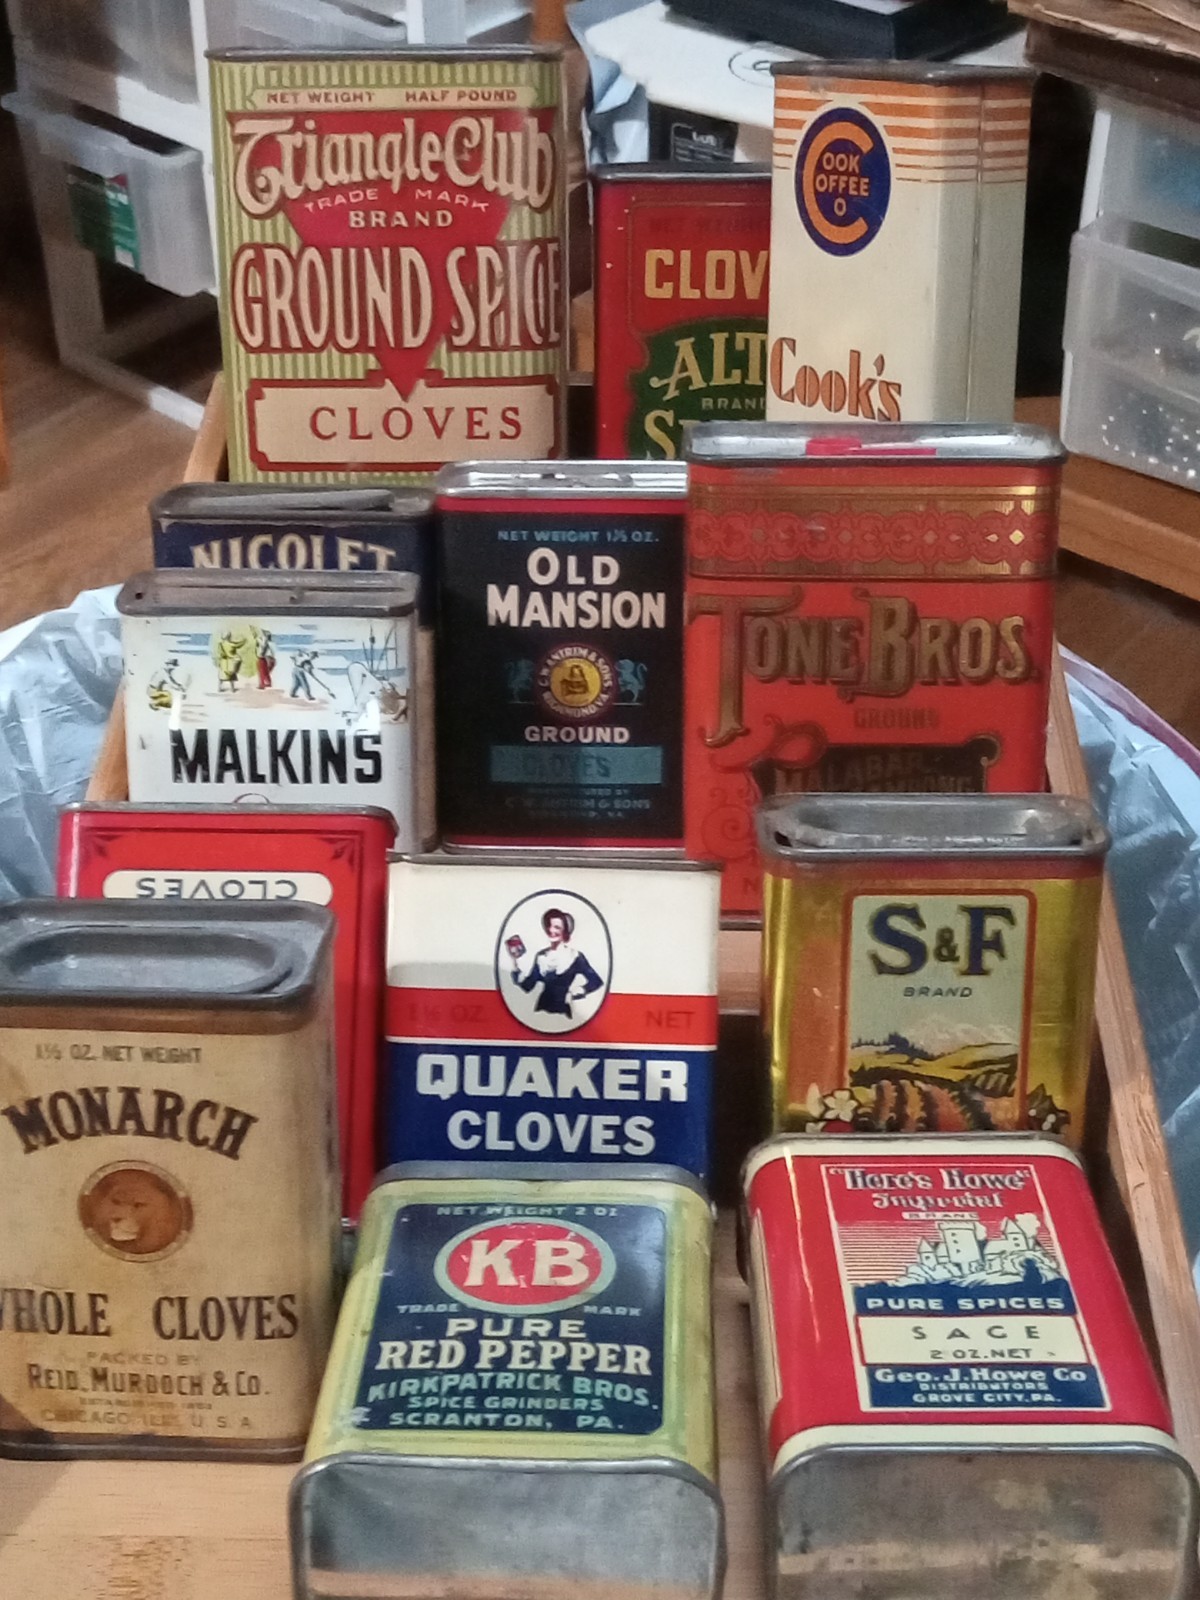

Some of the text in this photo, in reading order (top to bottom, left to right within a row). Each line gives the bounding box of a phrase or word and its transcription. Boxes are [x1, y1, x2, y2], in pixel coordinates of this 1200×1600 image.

[267, 90, 518, 104] NET WEIGHT HALF POUND
[233, 115, 555, 215] Triangle Club
[815, 173, 870, 197] OFFEE
[304, 188, 490, 212] TRADE MARK
[349, 210, 454, 229] BRAND
[234, 245, 561, 350] GROUND SPICE
[769, 336, 902, 422] Cook's
[701, 397, 767, 410] BRAN
[309, 406, 523, 441] CLOVES
[497, 530, 528, 542] NET
[534, 530, 599, 543] WEIGHT
[526, 546, 620, 586] OLD
[486, 583, 667, 629] MANSION
[688, 585, 862, 747] TONE
[524, 726, 631, 744] GROUND
[903, 986, 973, 998] BRAND
[645, 1010, 696, 1030] NET
[102, 1045, 135, 1062] NET
[139, 1046, 202, 1064] WEIGHT
[416, 1053, 688, 1101] QUAKER
[1, 1086, 259, 1160] MONARCH
[447, 1110, 656, 1156] CLOVES
[437, 1206, 477, 1216] NET
[484, 1206, 567, 1218] WEIGHT
[574, 1206, 588, 1217] 2
[463, 1239, 590, 1287] KB
[397, 1304, 643, 1317] TRADE MARK
[866, 1297, 1066, 1311] PURE SPICES
[153, 1293, 299, 1341] CLOVES
[446, 1318, 588, 1339] PURE
[86, 1351, 168, 1366] PACKED
[374, 1339, 653, 1377] RED PEPPER
[929, 1349, 944, 1360] 2
[90, 1366, 204, 1396] MURDOCH
[212, 1370, 230, 1397] &
[1052, 1367, 1088, 1382] Co
[367, 1371, 660, 1411] KIRKPATRICK BROS.
[918, 1382, 1050, 1392] DISTRIBUTORS
[407, 1396, 606, 1412] SPICE GRINDERS
[911, 1392, 976, 1404] GROVE
[389, 1412, 624, 1430] SCRANTON, PA.
